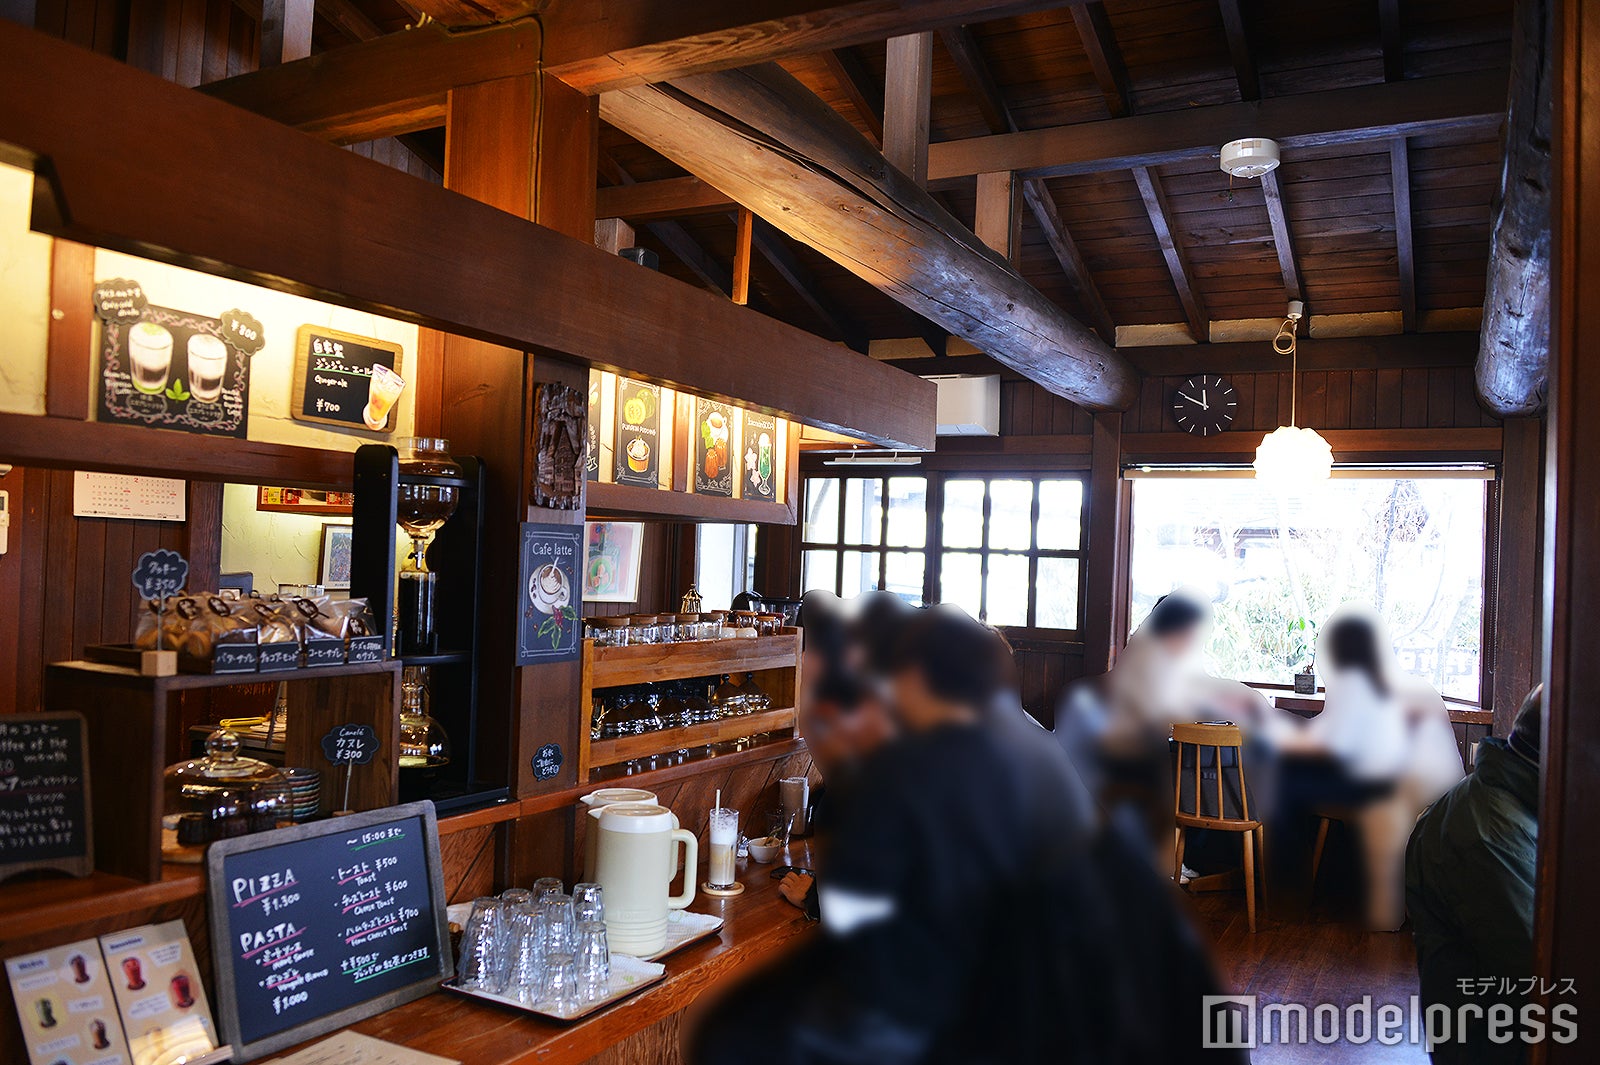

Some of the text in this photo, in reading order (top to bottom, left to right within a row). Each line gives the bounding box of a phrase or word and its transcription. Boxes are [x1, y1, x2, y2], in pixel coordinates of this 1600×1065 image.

[315, 398, 341, 413] ¥700
[553, 542, 573, 556] latte
[149, 560, 178, 576] クッキー
[336, 737, 365, 749] カヌレ
[336, 748, 363, 760] ¥300
[375, 856, 398, 872] ¥500
[232, 868, 296, 904] PIZZA
[385, 879, 408, 895] ¥600
[398, 907, 420, 922] ¥700
[239, 922, 297, 953] PASTA
